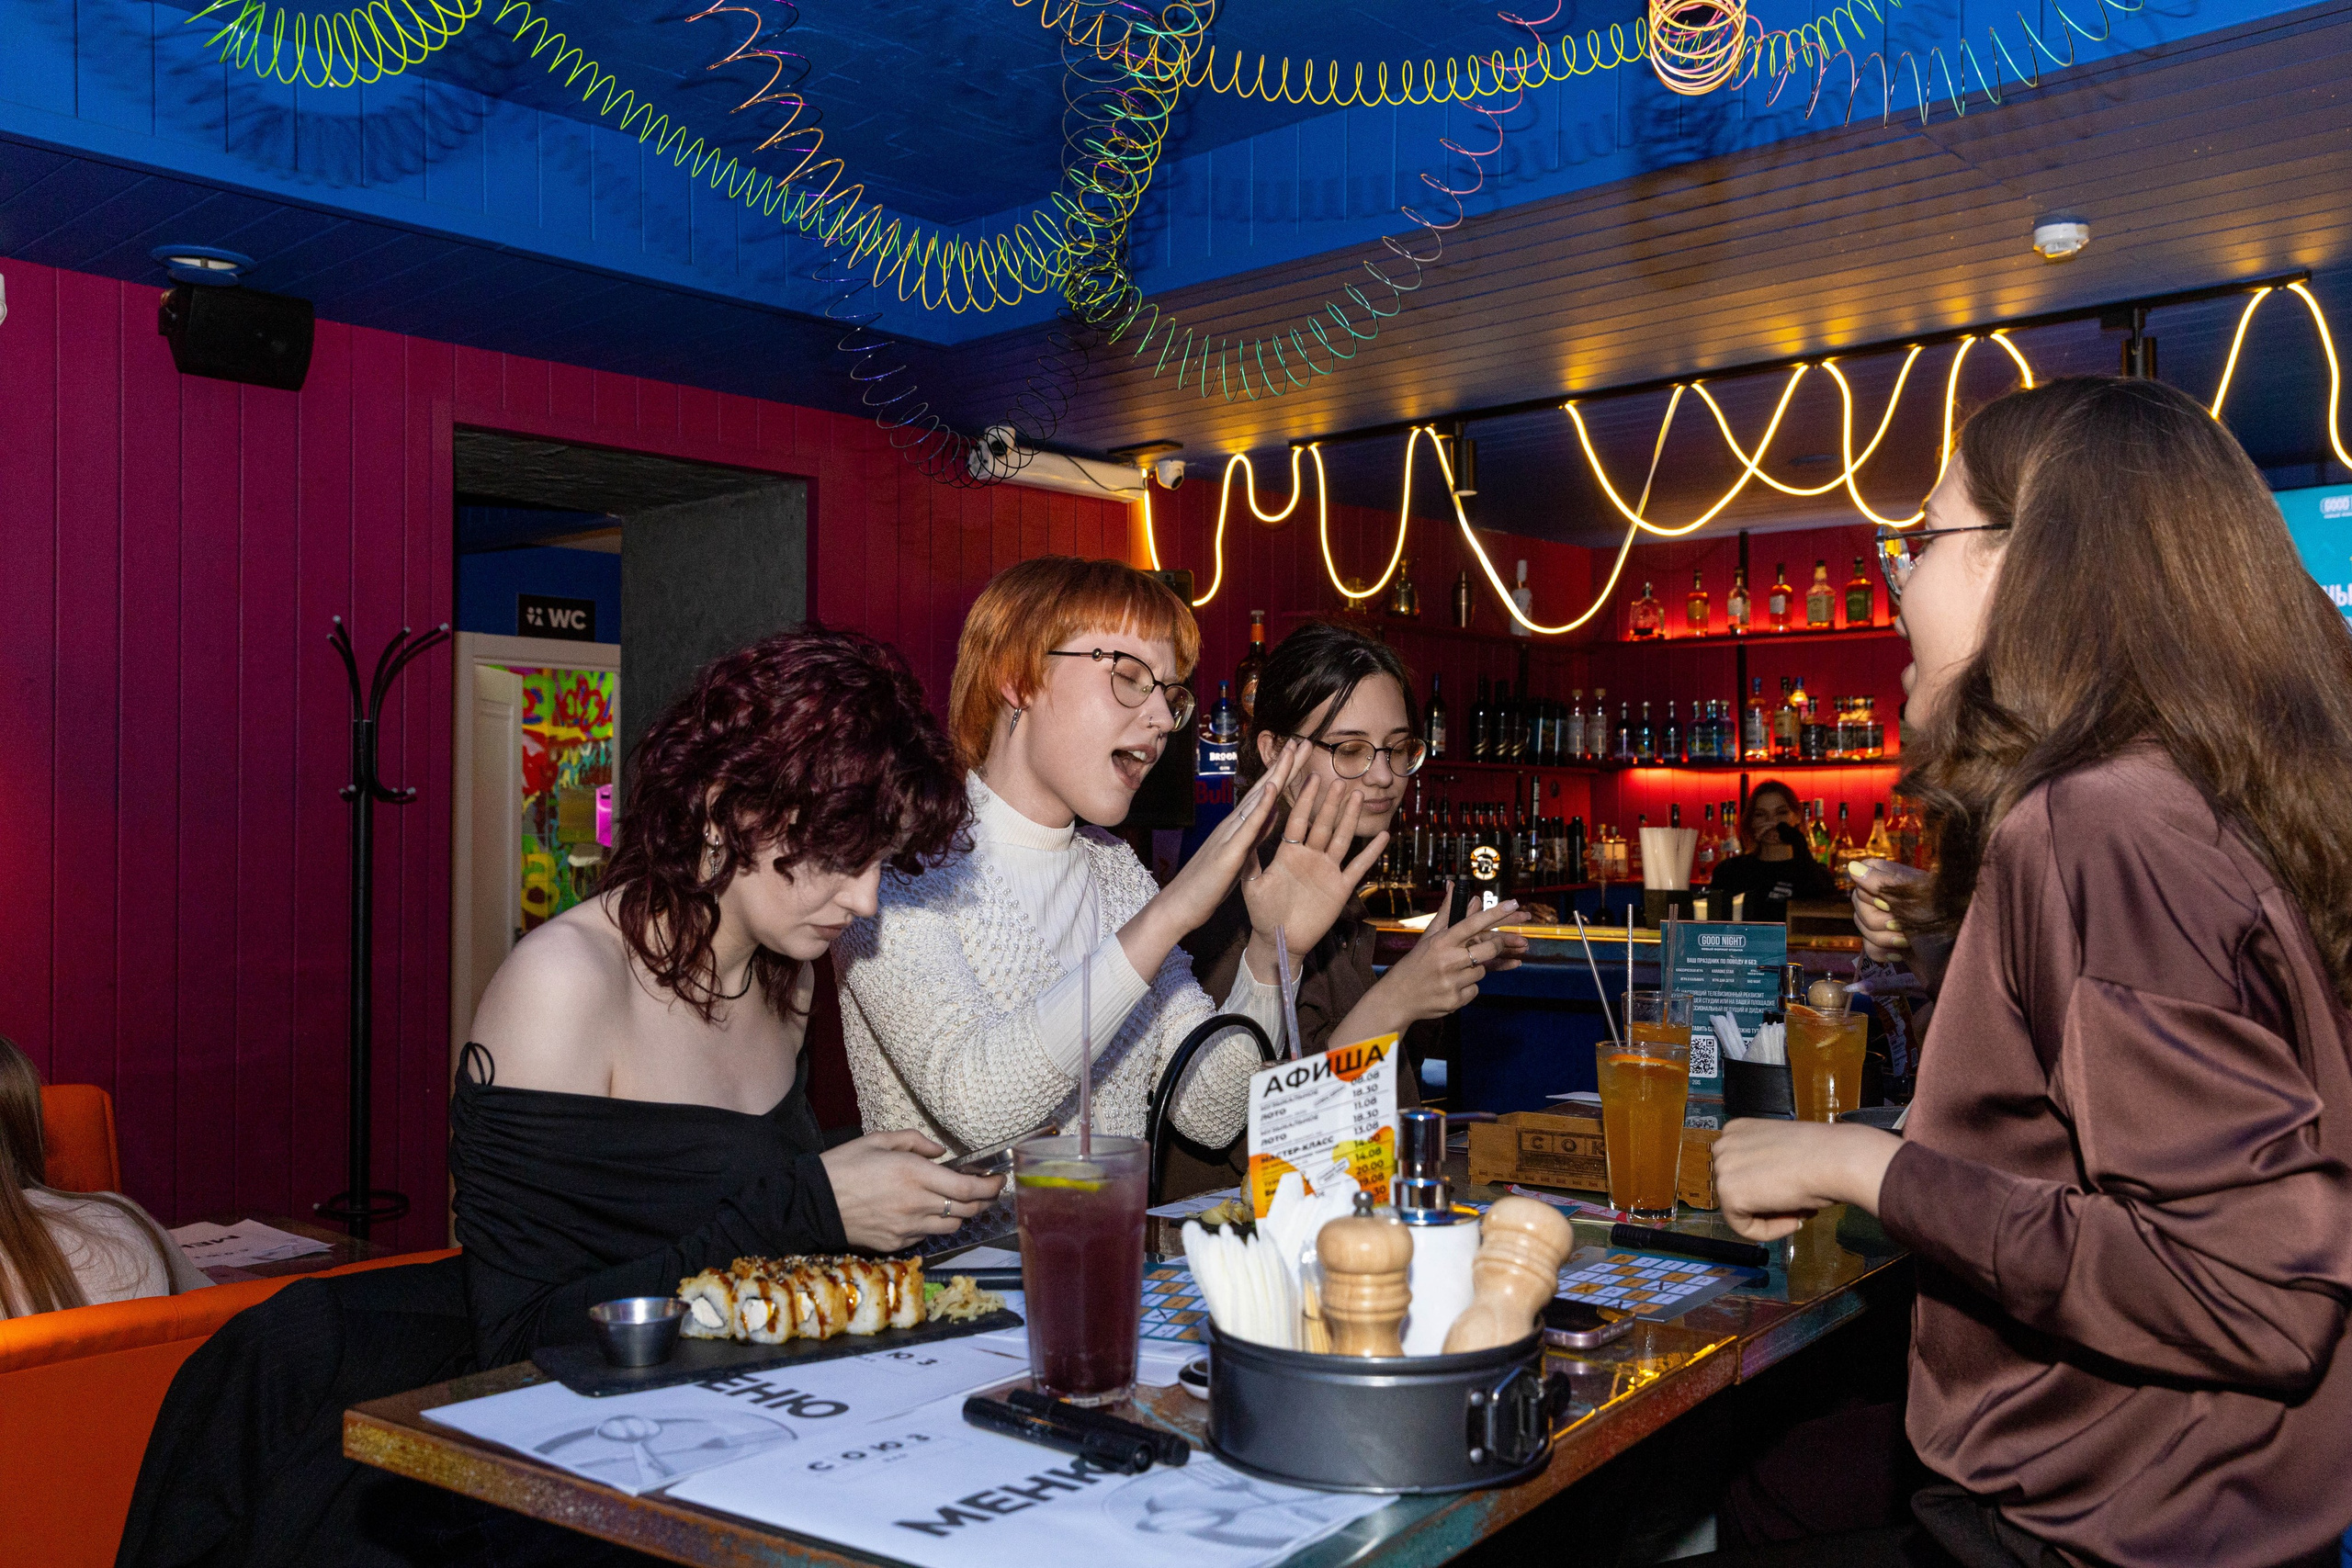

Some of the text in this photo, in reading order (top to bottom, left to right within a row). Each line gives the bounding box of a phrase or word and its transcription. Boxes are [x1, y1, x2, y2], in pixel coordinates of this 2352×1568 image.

[548, 608, 586, 630] WC
[1195, 779, 1232, 804] Bull
[1702, 936, 1742, 946] GOOD NIGHT
[1263, 1044, 1385, 1098] АФИША
[1351, 1071, 1379, 1086] 08.08
[1353, 1084, 1378, 1097] 18.30
[1354, 1097, 1377, 1110] 11.08
[1261, 1109, 1286, 1121] ЛОТО
[1353, 1109, 1378, 1122] 18.30
[1354, 1122, 1379, 1134] 13.08
[1261, 1134, 1286, 1145] ЛОТО
[1261, 1136, 1333, 1163] МАСТЕР-КЛАСС
[1356, 1159, 1384, 1174] 20.00
[1374, 1185, 1385, 1194] 30
[695, 1374, 850, 1418] ЕНЮ
